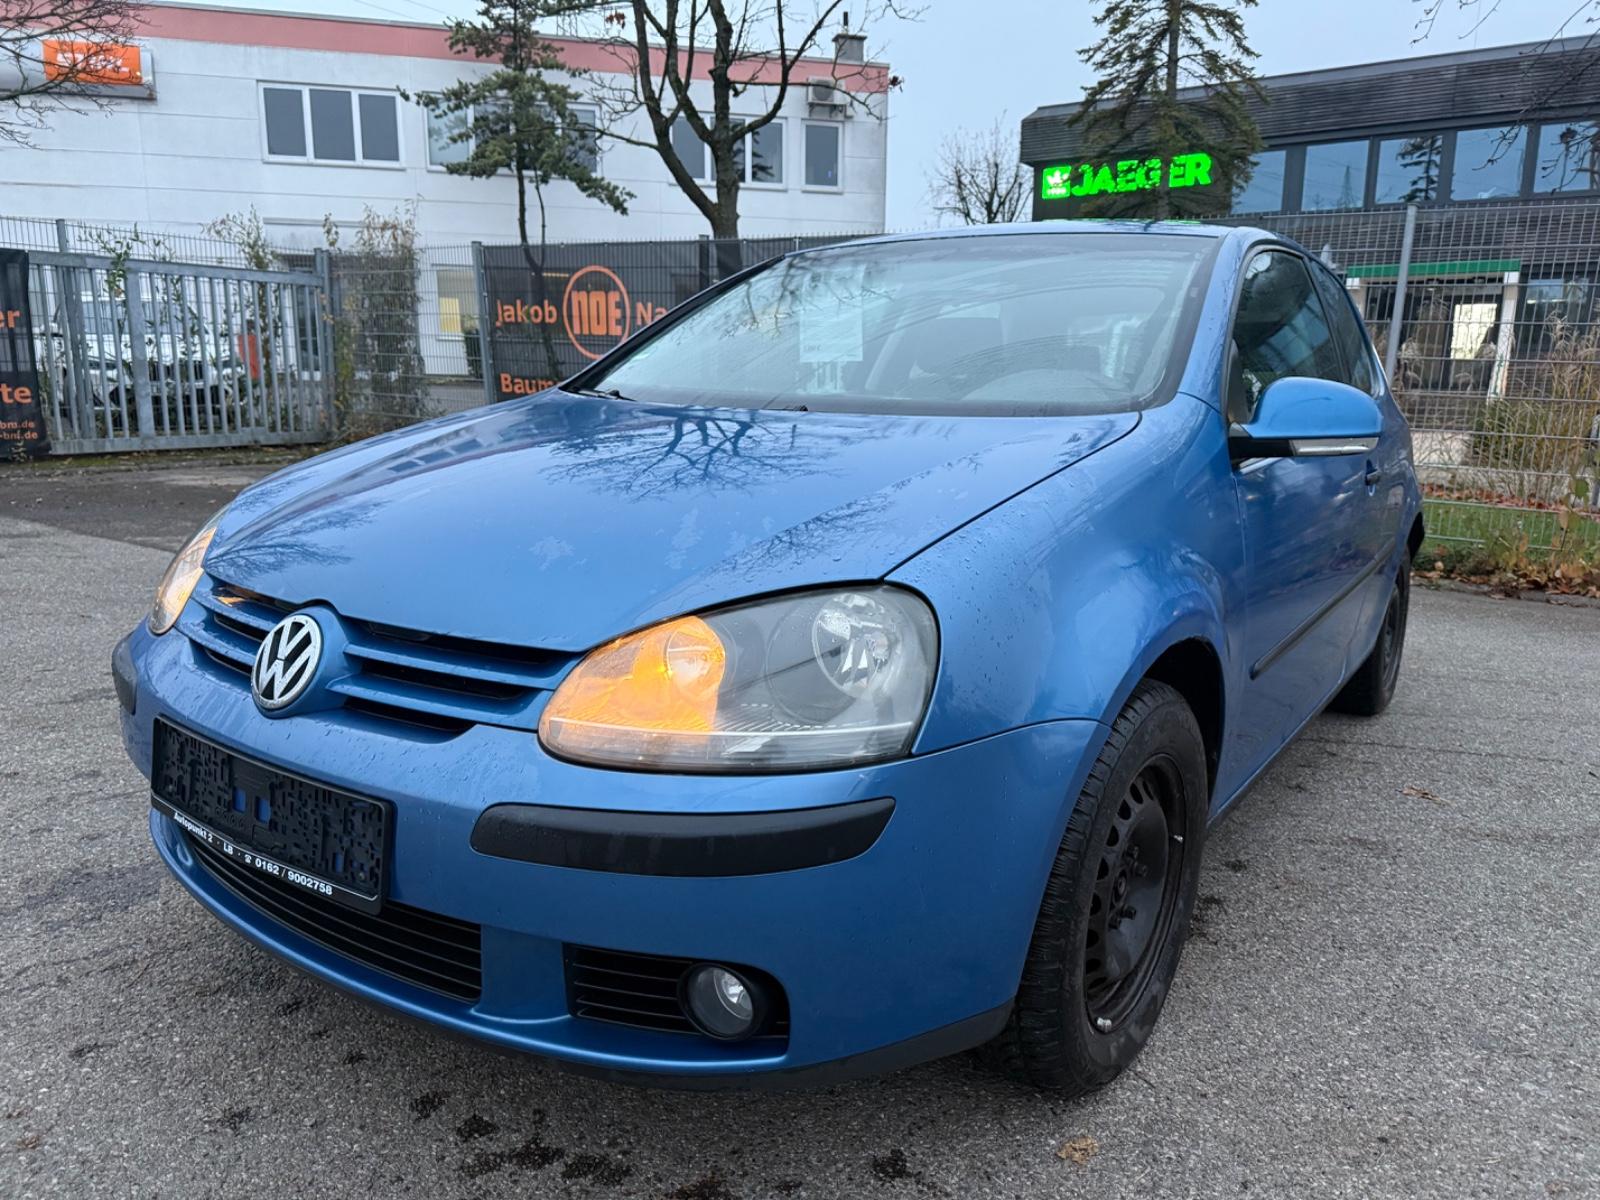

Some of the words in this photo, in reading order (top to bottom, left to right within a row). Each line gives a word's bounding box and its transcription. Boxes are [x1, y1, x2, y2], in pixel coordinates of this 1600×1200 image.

[1071, 152, 1212, 196] JAEGER
[495, 299, 557, 327] Jakob
[253, 614, 321, 703] VW
[174, 812, 207, 840] Autopunkt
[207, 833, 213, 844] 2
[223, 841, 234, 855] LB
[255, 858, 280, 875] 0162
[287, 870, 333, 896] 9002758
